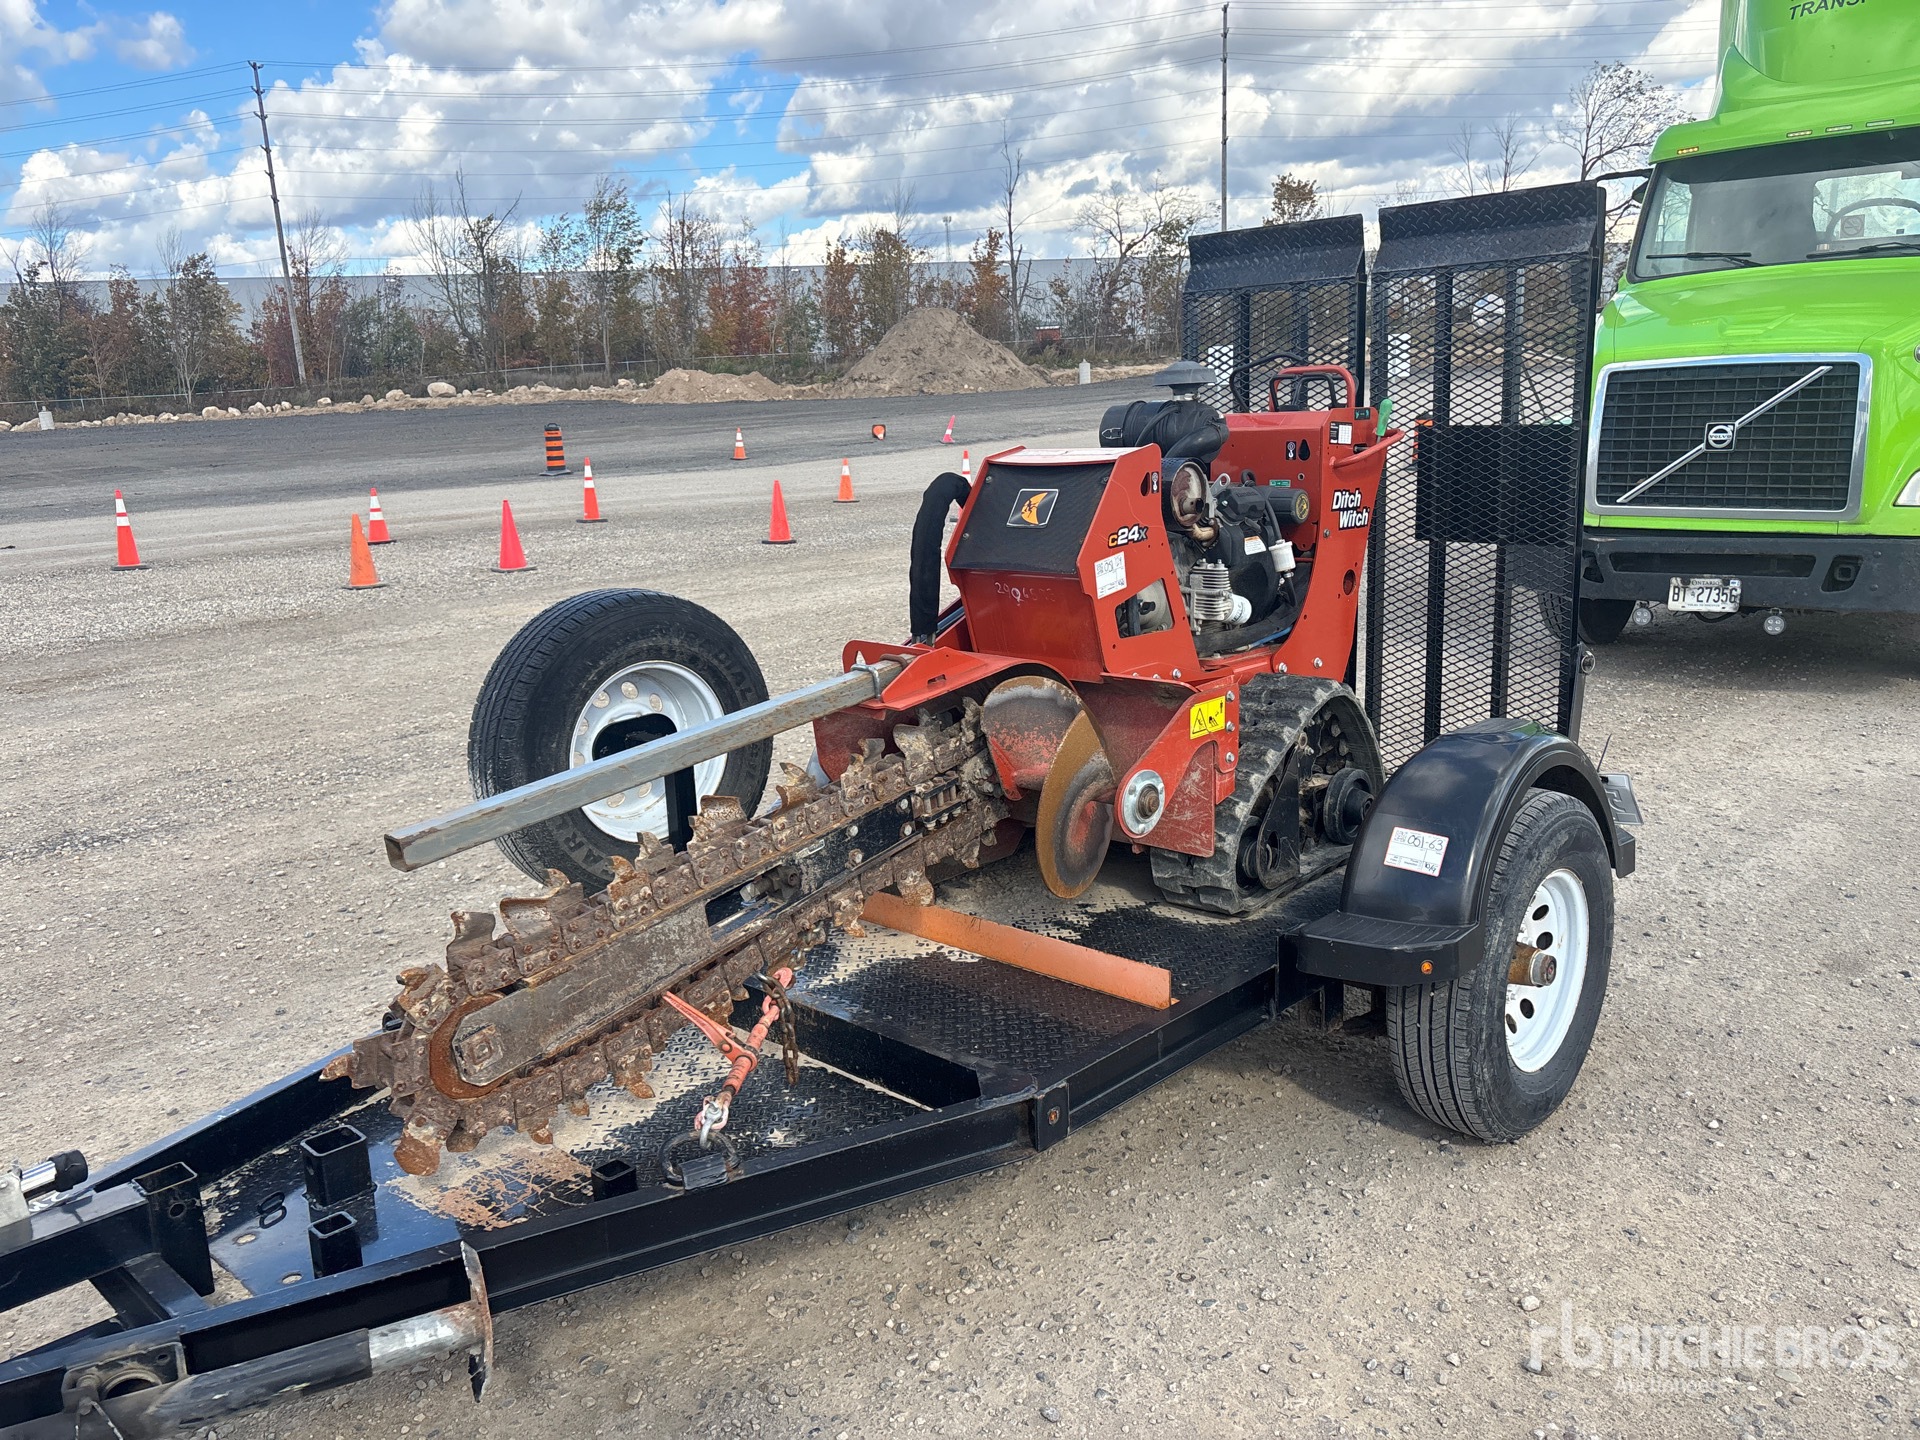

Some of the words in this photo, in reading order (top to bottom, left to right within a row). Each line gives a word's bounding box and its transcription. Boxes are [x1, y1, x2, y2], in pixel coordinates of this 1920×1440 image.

[1332, 489, 1361, 510] Ditch
[1339, 508, 1369, 529] Witch
[1672, 586, 1690, 602] BT
[1696, 587, 1738, 603] 27356
